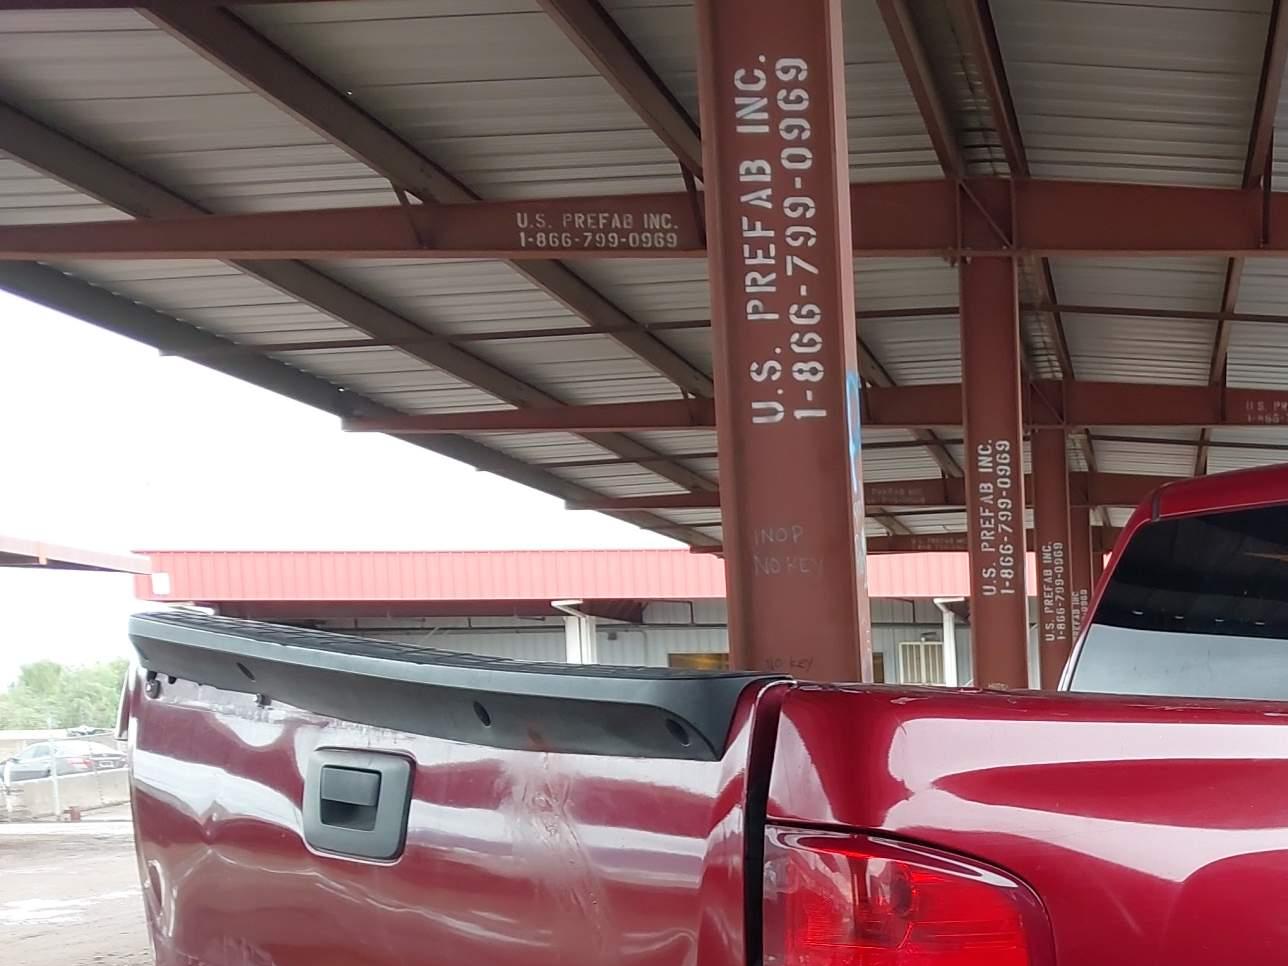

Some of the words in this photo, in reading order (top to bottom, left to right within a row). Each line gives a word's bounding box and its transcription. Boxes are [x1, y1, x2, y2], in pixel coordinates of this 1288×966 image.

[734, 55, 770, 133] INC.
[516, 212, 552, 229] U.S.
[563, 213, 634, 229] PREFAB
[643, 213, 679, 229] INC.
[519, 231, 678, 248] 1-866-799-0969
[739, 159, 780, 320] PREFAB
[775, 58, 827, 420] 1-866-799-0969
[750, 347, 785, 424] U.S.
[977, 439, 993, 473] INC.
[979, 482, 995, 552] PREFAB
[995, 440, 1015, 594] 1-866-799-0969
[982, 562, 997, 596] U.S.
[1043, 569, 1054, 614] PREFAB
